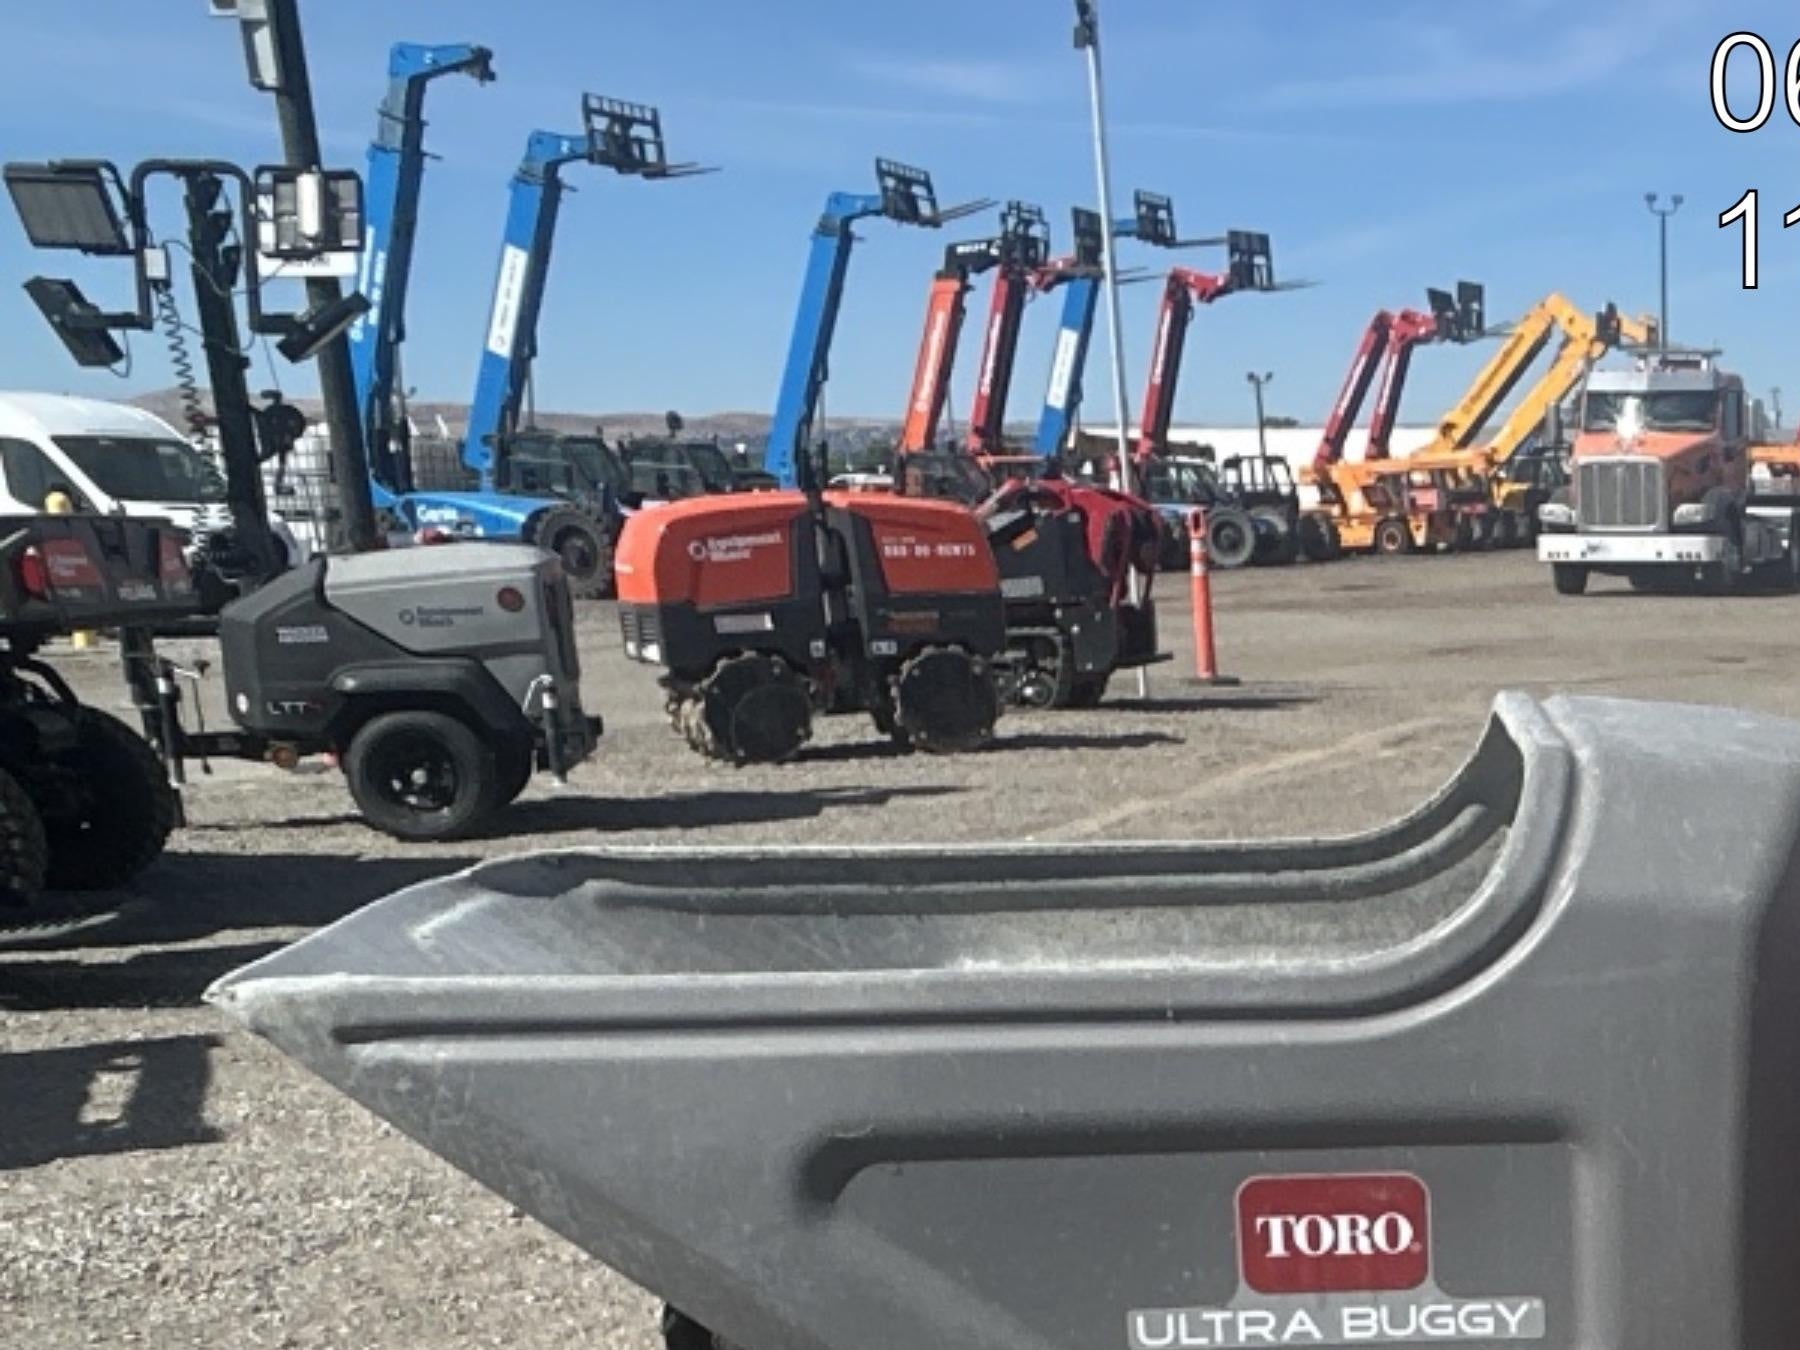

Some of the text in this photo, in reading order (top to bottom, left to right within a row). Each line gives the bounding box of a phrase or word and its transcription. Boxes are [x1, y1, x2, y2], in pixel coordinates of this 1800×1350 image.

[1256, 1211, 1414, 1257] TORO
[1136, 1301, 1530, 1347] ULTRA BUGGY
